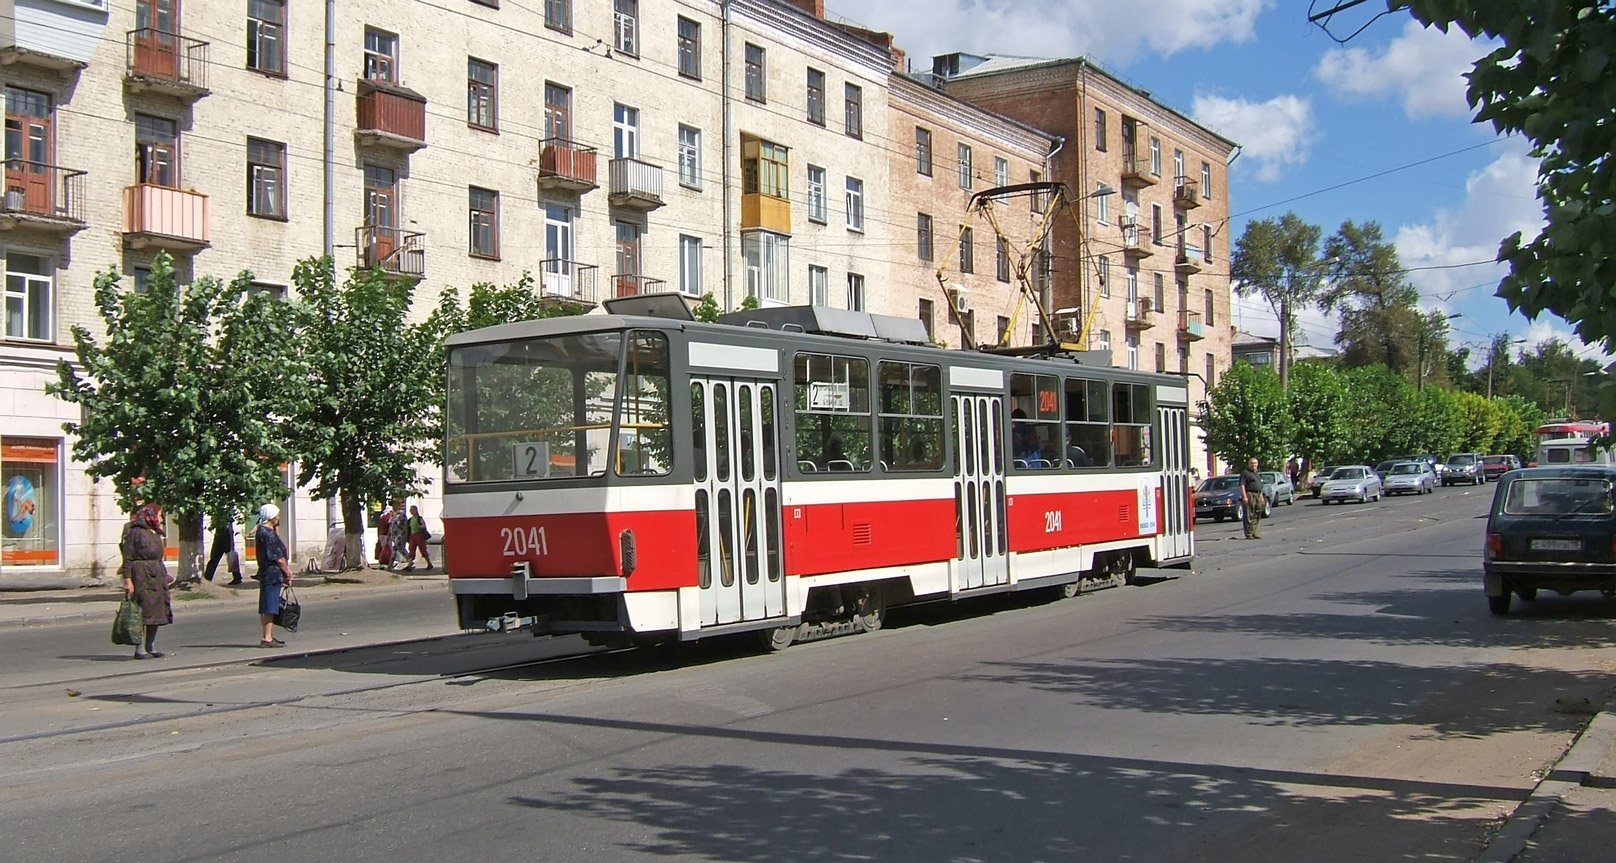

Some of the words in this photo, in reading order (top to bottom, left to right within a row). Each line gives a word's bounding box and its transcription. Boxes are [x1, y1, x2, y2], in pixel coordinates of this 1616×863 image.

[812, 385, 819, 405] 2
[1039, 390, 1057, 412] 2041
[525, 446, 537, 475] 2
[1044, 510, 1062, 533] 2041
[500, 526, 548, 556] 2041
